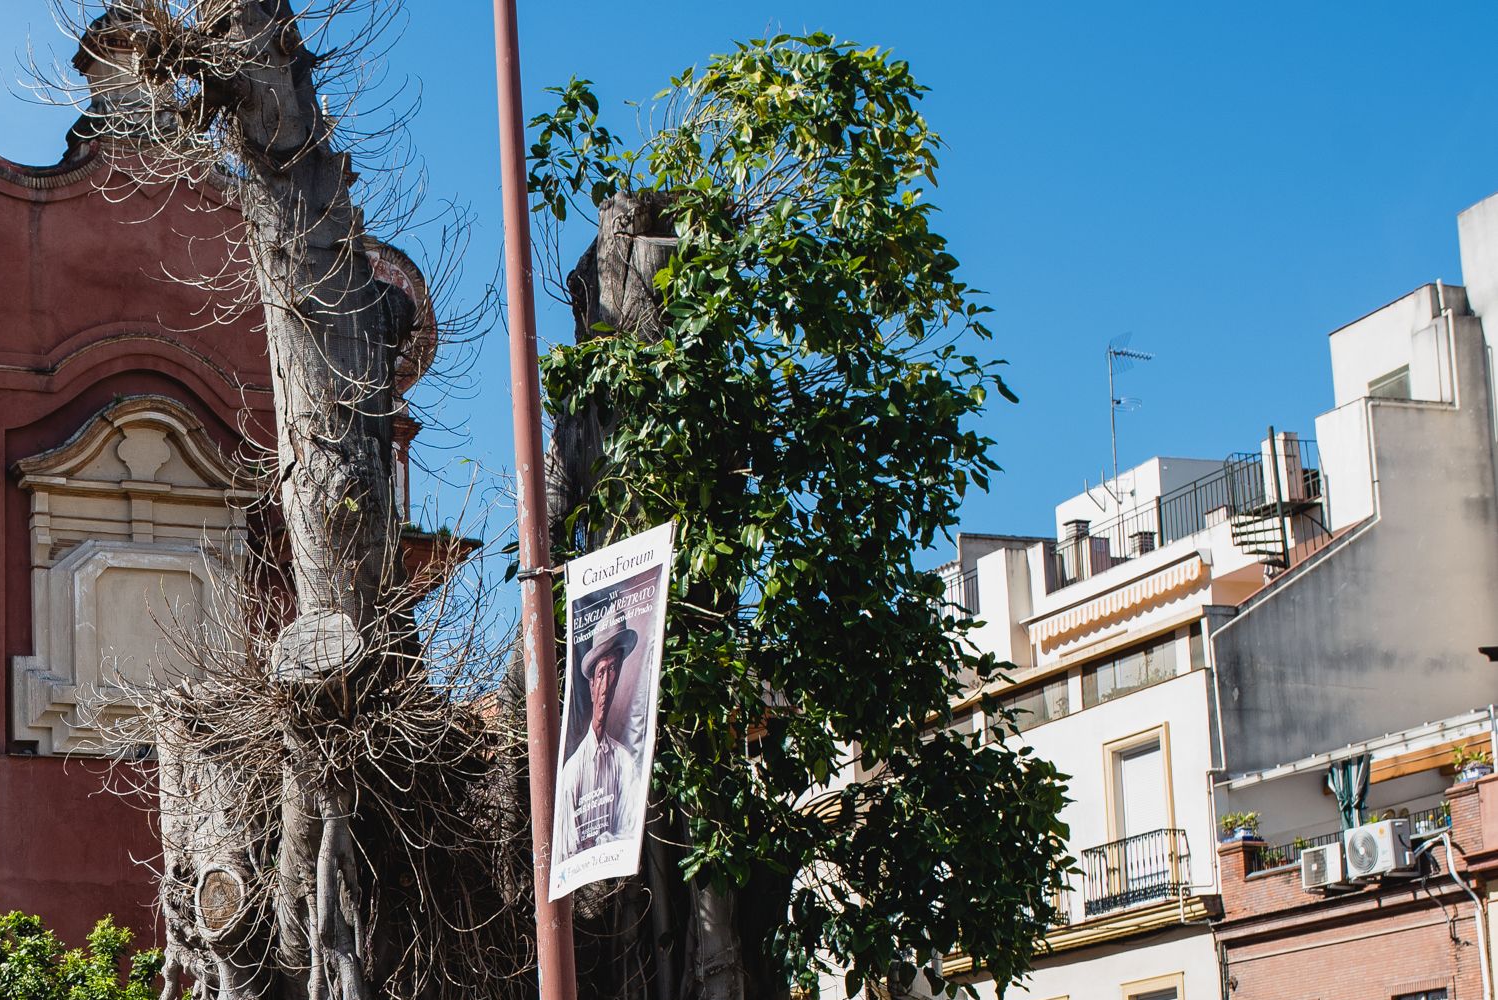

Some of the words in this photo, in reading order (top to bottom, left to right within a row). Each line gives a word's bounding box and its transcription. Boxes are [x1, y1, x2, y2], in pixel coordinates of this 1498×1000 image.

[582, 549, 654, 586] CaixaForum
[573, 616, 583, 631] EL
[583, 605, 607, 628] SIGLO
[615, 585, 656, 612] RETRATO
[634, 603, 653, 619] Prado
